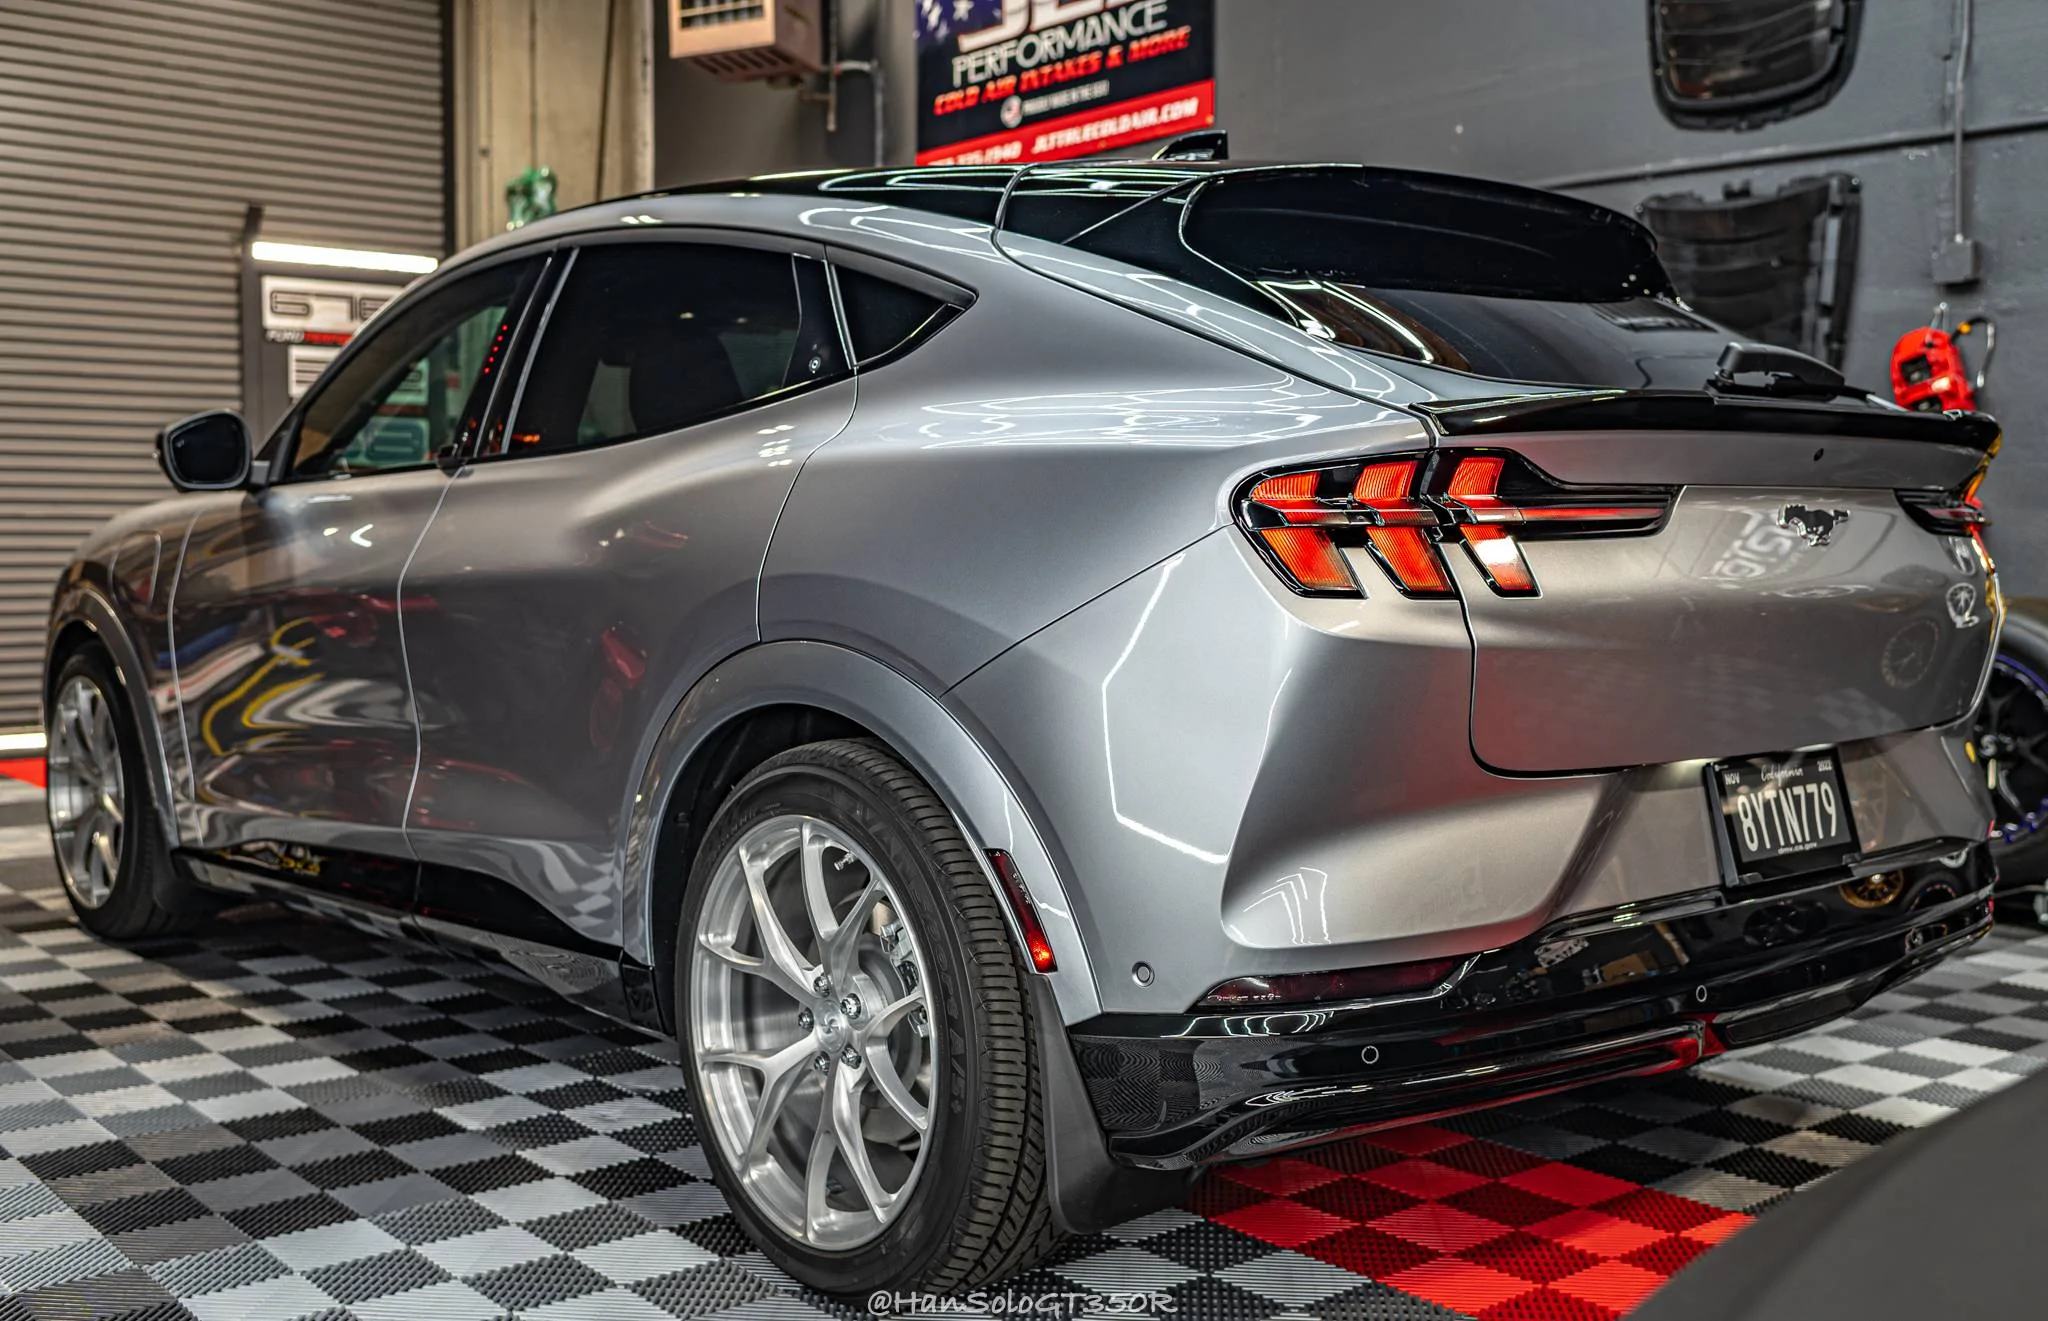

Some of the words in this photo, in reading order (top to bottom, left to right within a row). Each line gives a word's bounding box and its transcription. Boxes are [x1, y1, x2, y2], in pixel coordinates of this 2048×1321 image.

[933, 85, 980, 116] COLD
[982, 75, 1017, 103] AIR
[1019, 51, 1103, 93] INTAKES
[1106, 45, 1124, 69] &
[1128, 26, 1191, 64] MORE
[953, 2, 1169, 87] PERFORMANCE
[1724, 772, 1740, 785] NOV
[1760, 763, 1804, 787] California
[1737, 781, 1837, 852] 8YTN779
